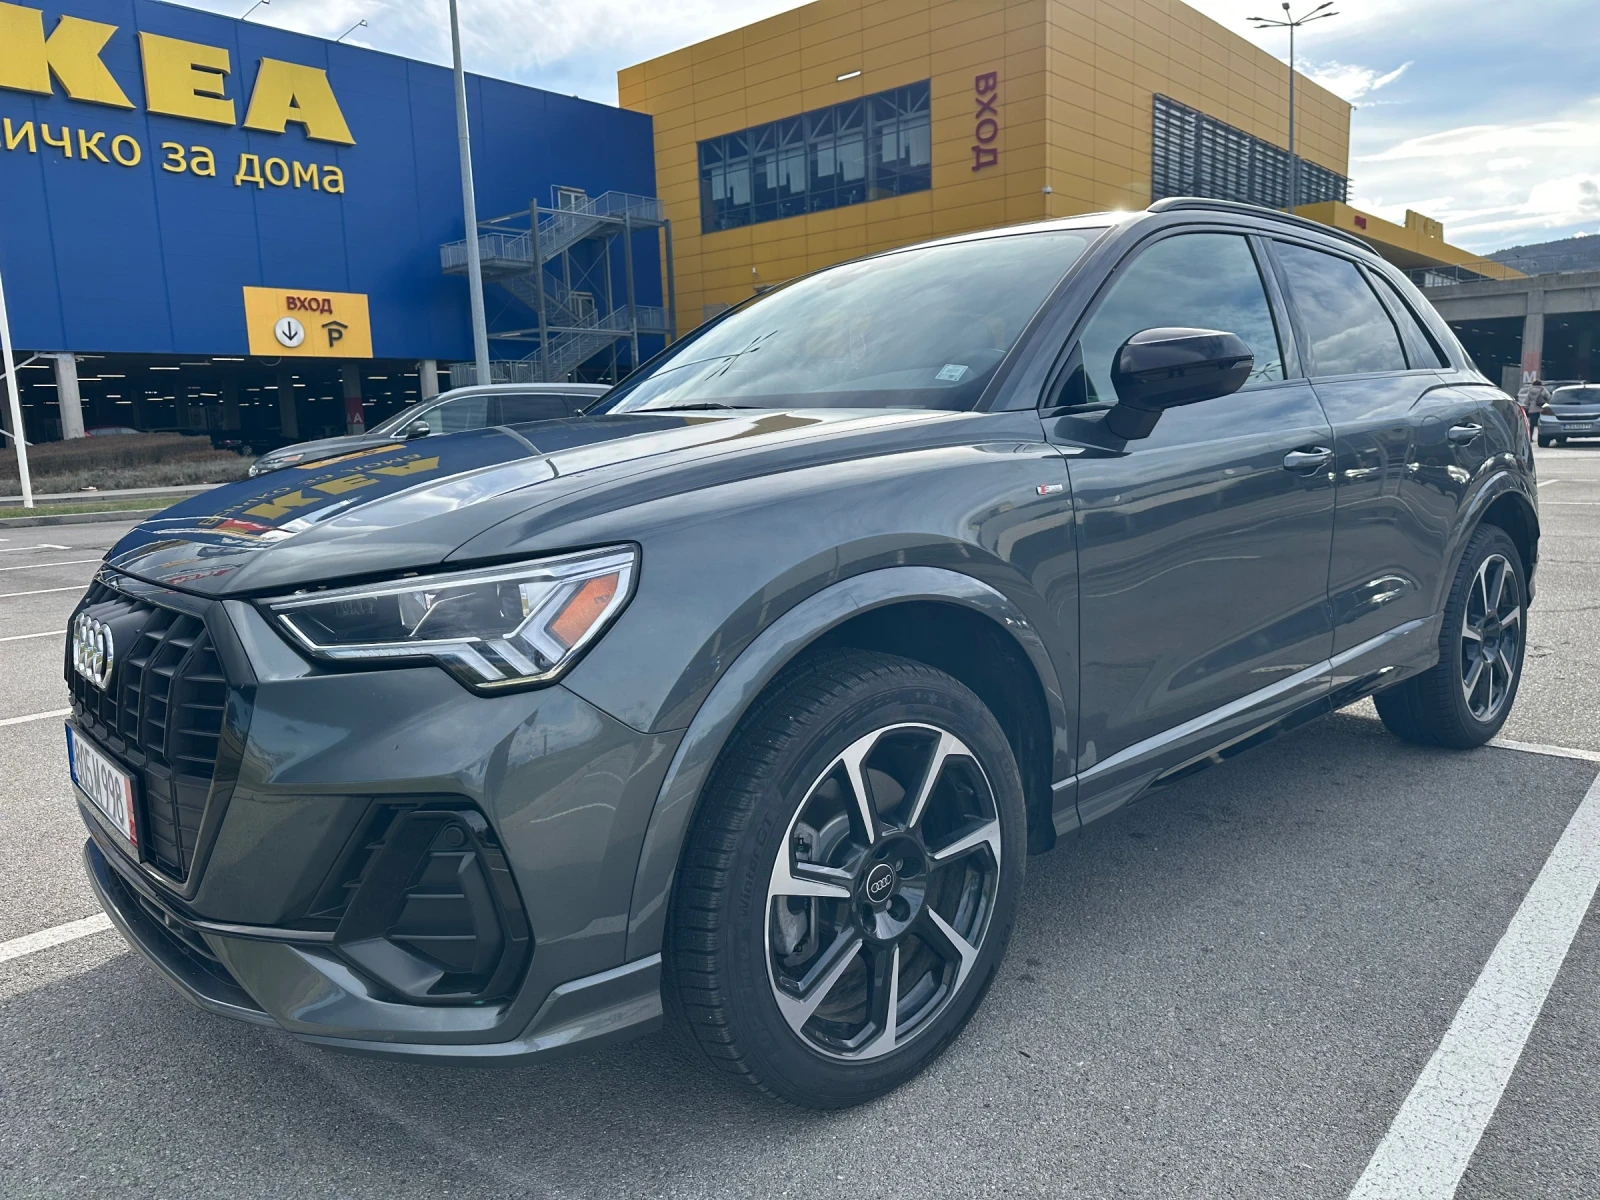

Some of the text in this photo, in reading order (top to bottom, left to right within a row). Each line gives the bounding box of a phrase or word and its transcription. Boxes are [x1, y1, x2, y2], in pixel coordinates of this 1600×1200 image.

[971, 71, 998, 172] ВХОД
[0, 118, 345, 194] ичко за дома
[286, 296, 333, 315] ВХОД
[328, 328, 343, 348] P
[1523, 371, 1537, 383] M
[353, 412, 363, 423] A
